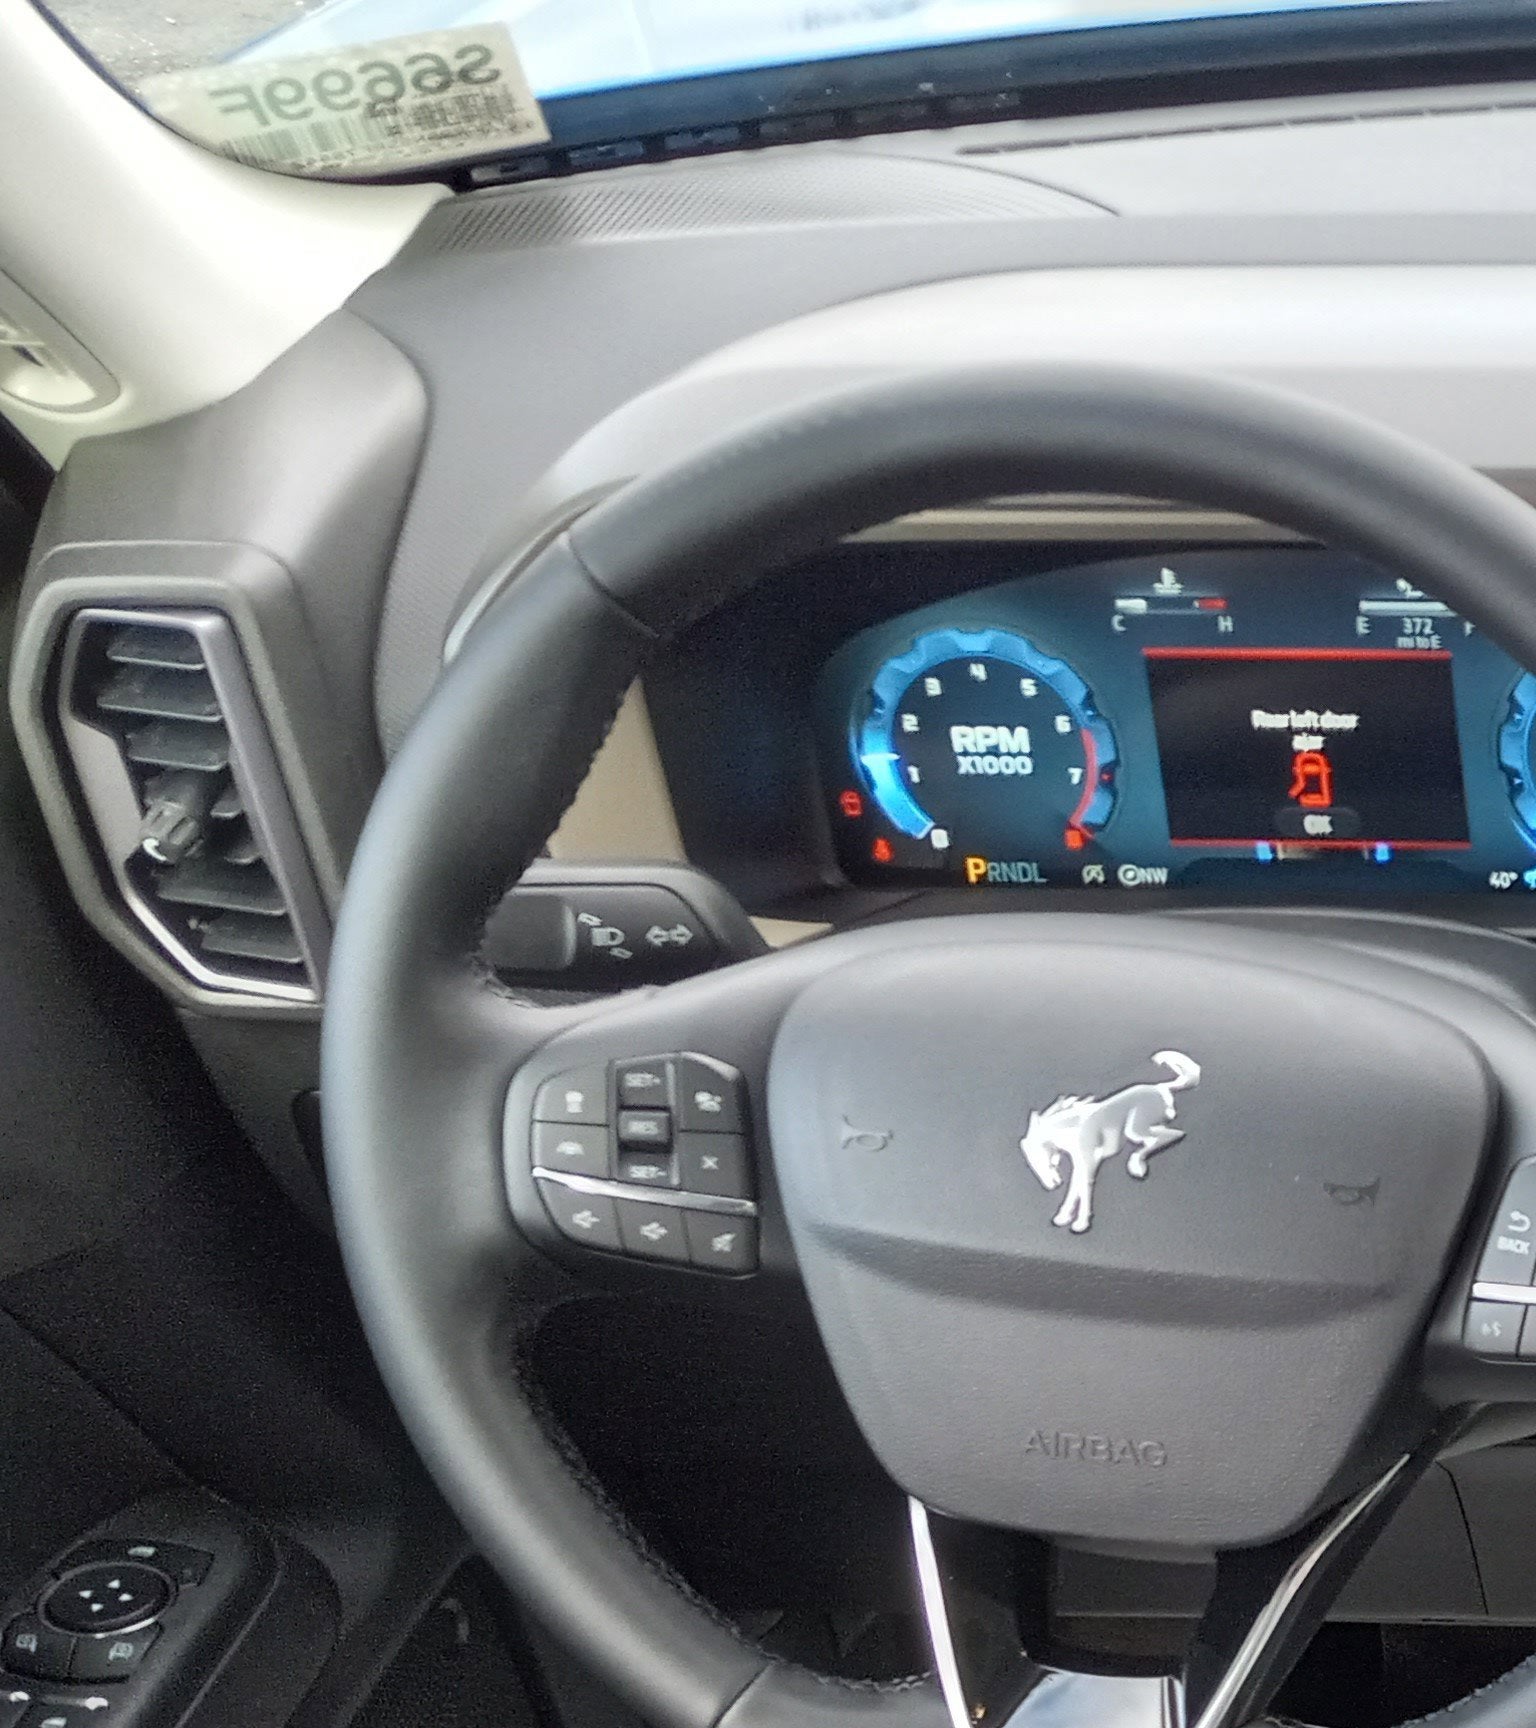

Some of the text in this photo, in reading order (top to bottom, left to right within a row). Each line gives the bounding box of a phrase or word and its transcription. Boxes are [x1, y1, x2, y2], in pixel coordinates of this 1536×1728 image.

[1111, 616, 1126, 633] C
[1217, 615, 1234, 633] H
[1356, 616, 1372, 636] E
[1402, 617, 1435, 636] 372
[969, 663, 988, 682] 4
[924, 677, 943, 697] 3
[1020, 678, 1039, 698] 5
[901, 713, 920, 733] 2
[1054, 714, 1072, 734] 6
[950, 725, 1031, 754] RPM
[907, 765, 921, 783] 1
[1067, 767, 1084, 785] 7
[1497, 1235, 1530, 1255] BACK
[1026, 1430, 1168, 1468] AIRBAG
